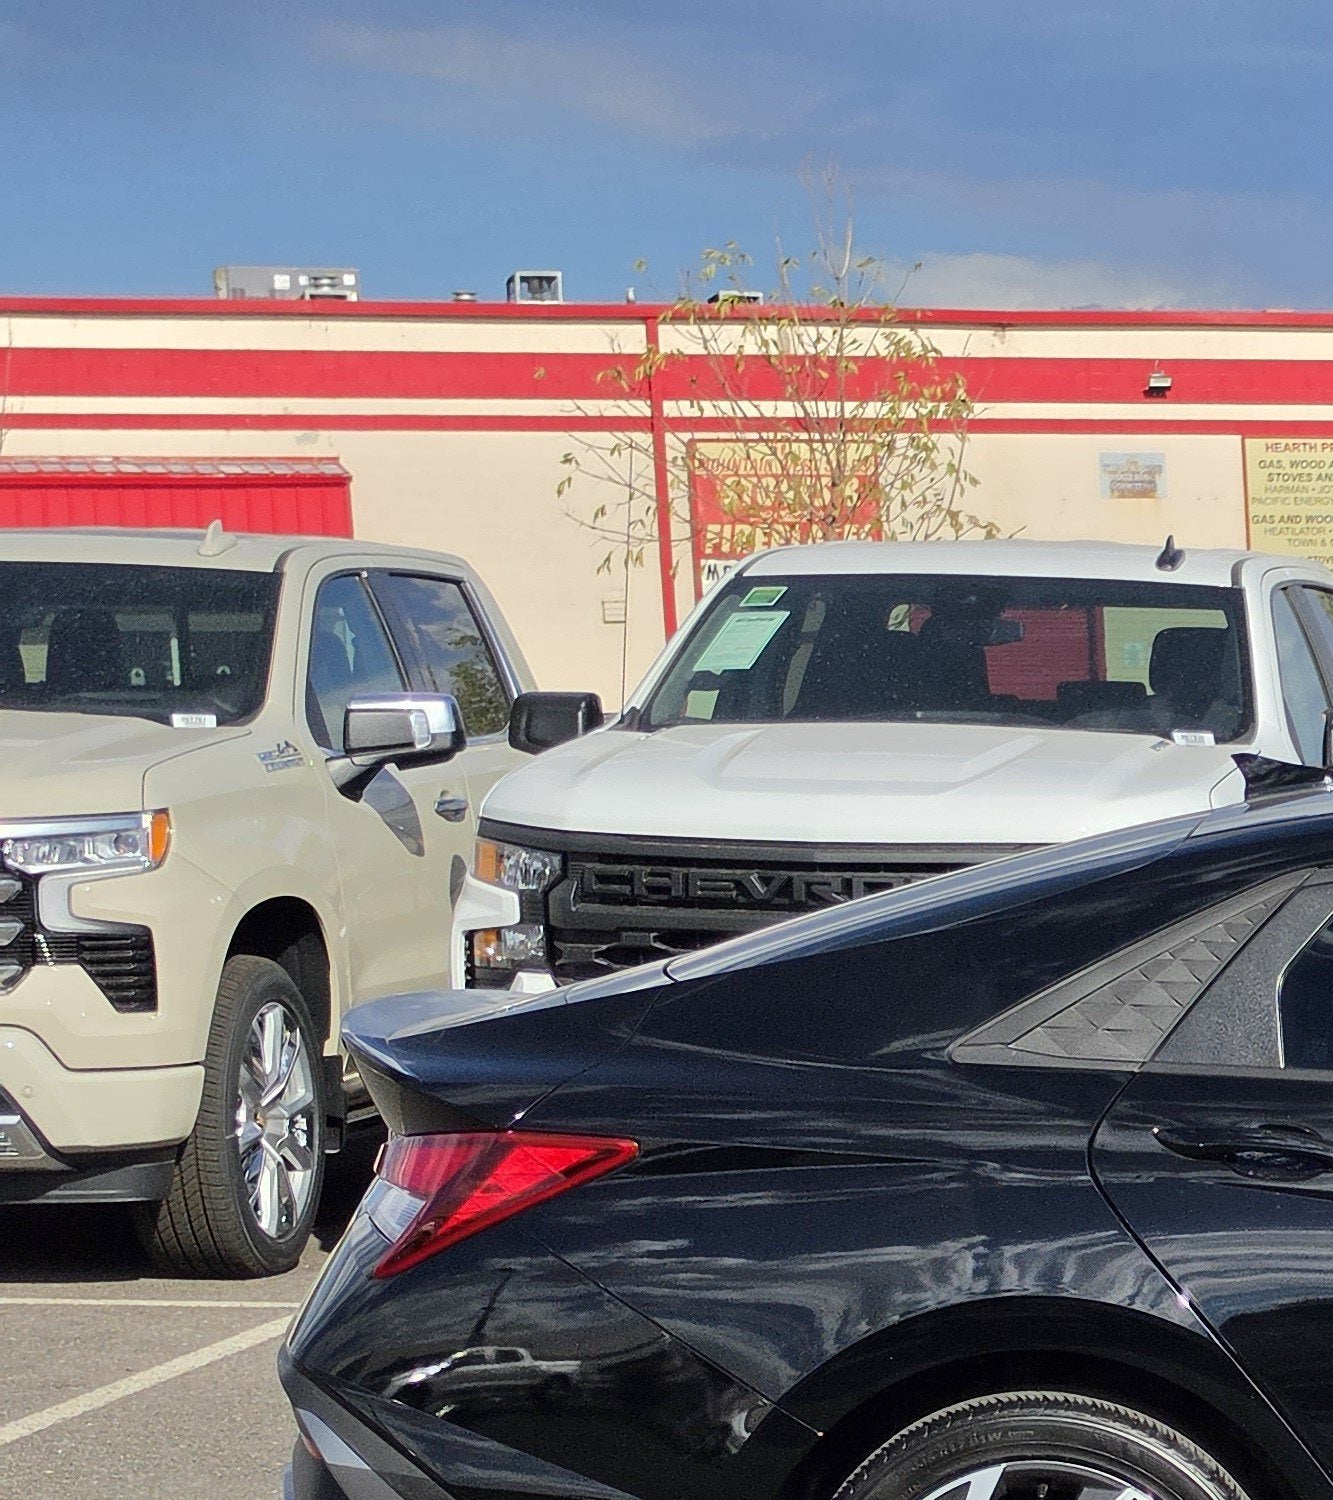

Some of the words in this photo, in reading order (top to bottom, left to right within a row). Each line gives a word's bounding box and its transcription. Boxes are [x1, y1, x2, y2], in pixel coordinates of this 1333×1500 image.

[1265, 442, 1318, 453] HEARTH
[1289, 460, 1326, 470] WOOD
[1266, 472, 1313, 482] STOVES
[1252, 514, 1276, 524] GAS
[1278, 514, 1302, 524] AND
